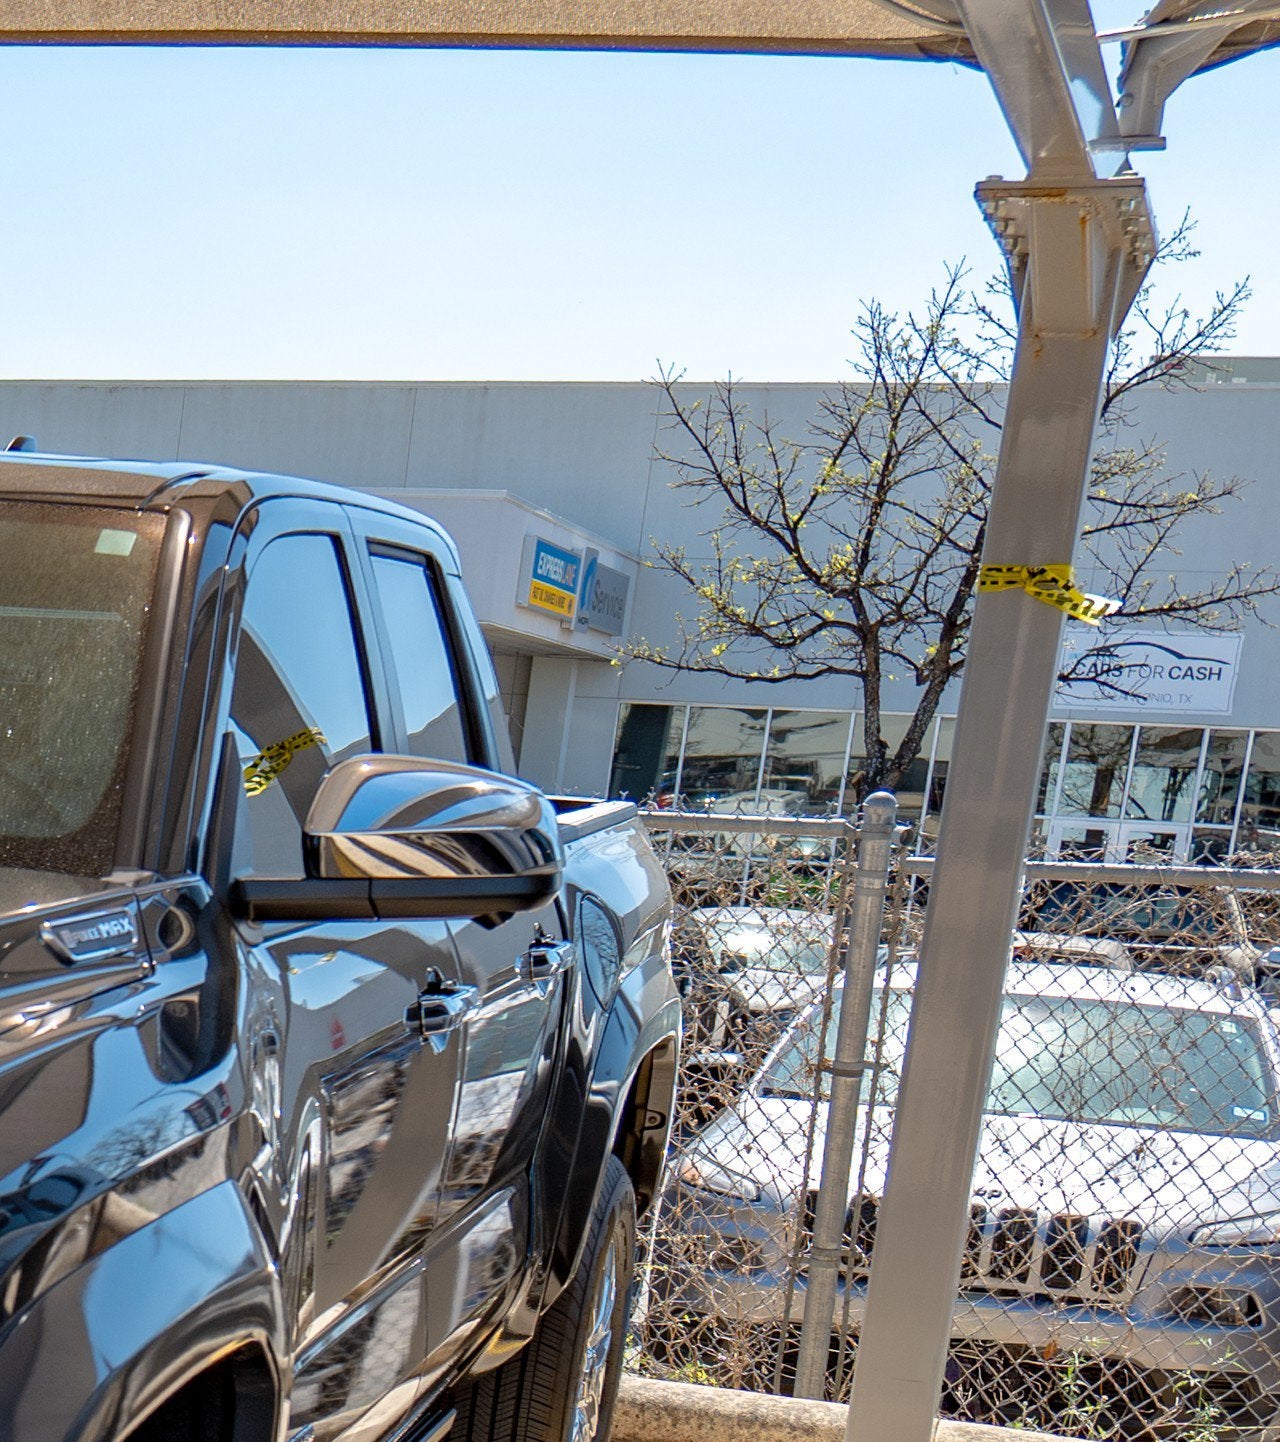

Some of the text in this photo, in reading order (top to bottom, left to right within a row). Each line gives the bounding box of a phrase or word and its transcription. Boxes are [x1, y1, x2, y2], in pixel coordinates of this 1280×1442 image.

[592, 579, 623, 620] Service
[1128, 664, 1165, 679] FOR
[1168, 665, 1223, 681] CASH
[1179, 693, 1194, 704] TX
[98, 917, 134, 938] MAX
